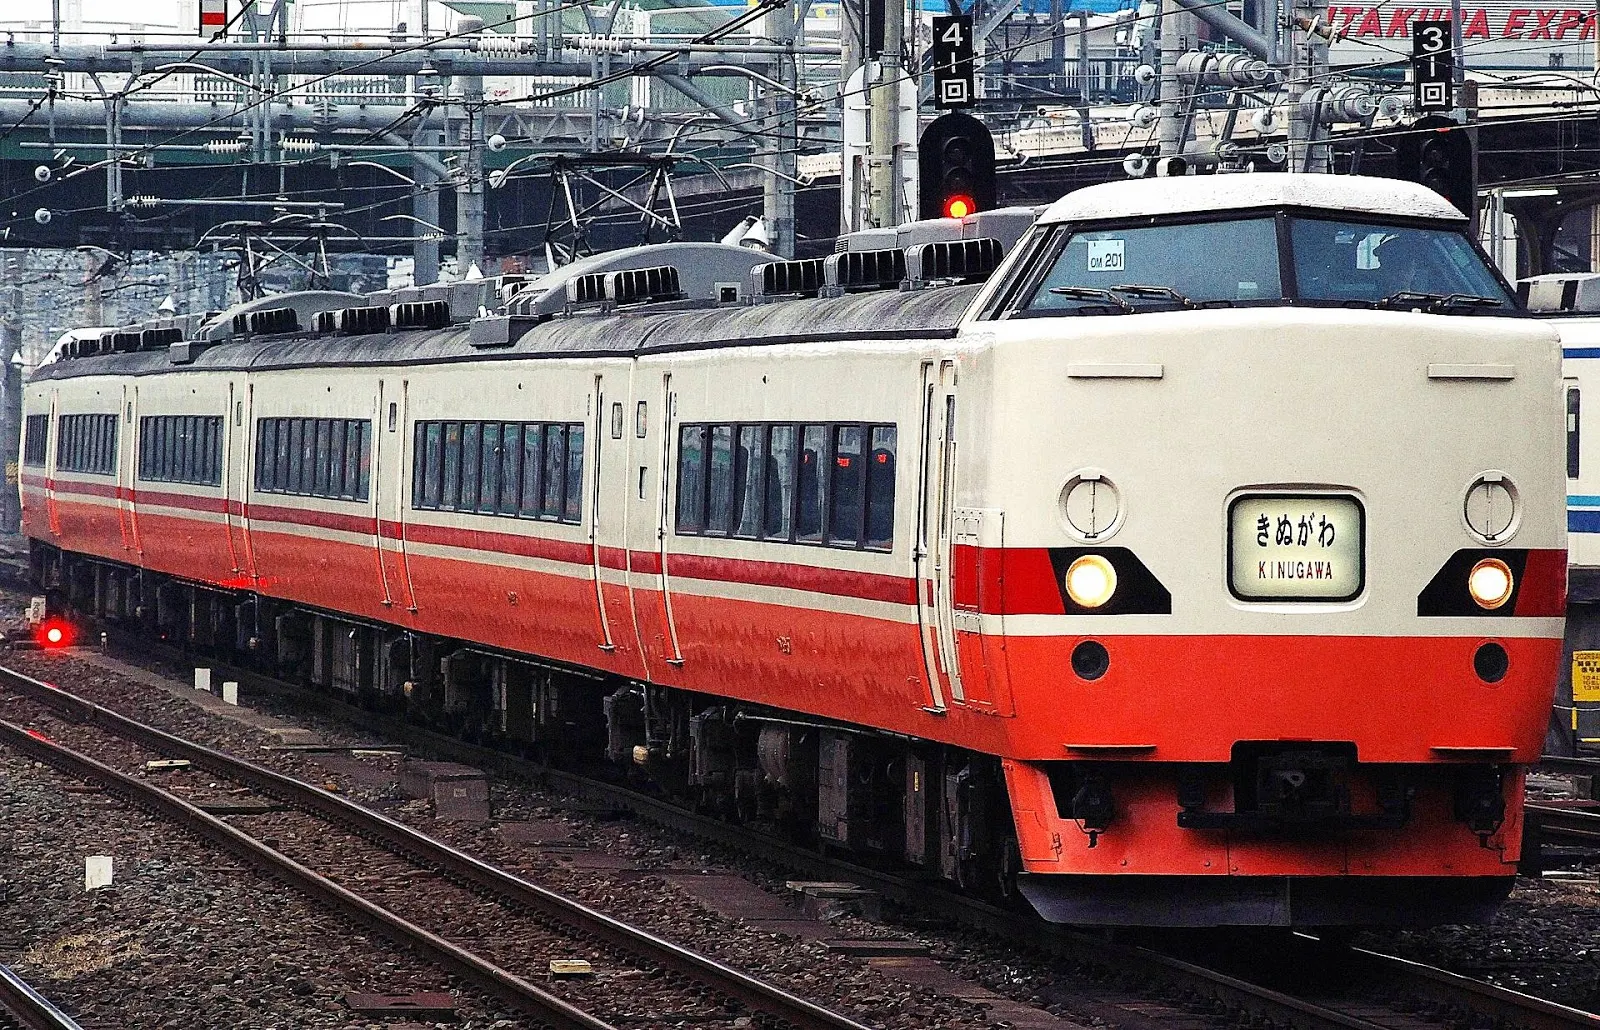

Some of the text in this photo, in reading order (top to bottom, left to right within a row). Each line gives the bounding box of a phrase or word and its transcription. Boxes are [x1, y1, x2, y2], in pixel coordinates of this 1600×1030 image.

[1104, 252, 1122, 268] 201
[1257, 512, 1335, 548] きぬがわ
[1258, 561, 1333, 580] KINUGAWA
